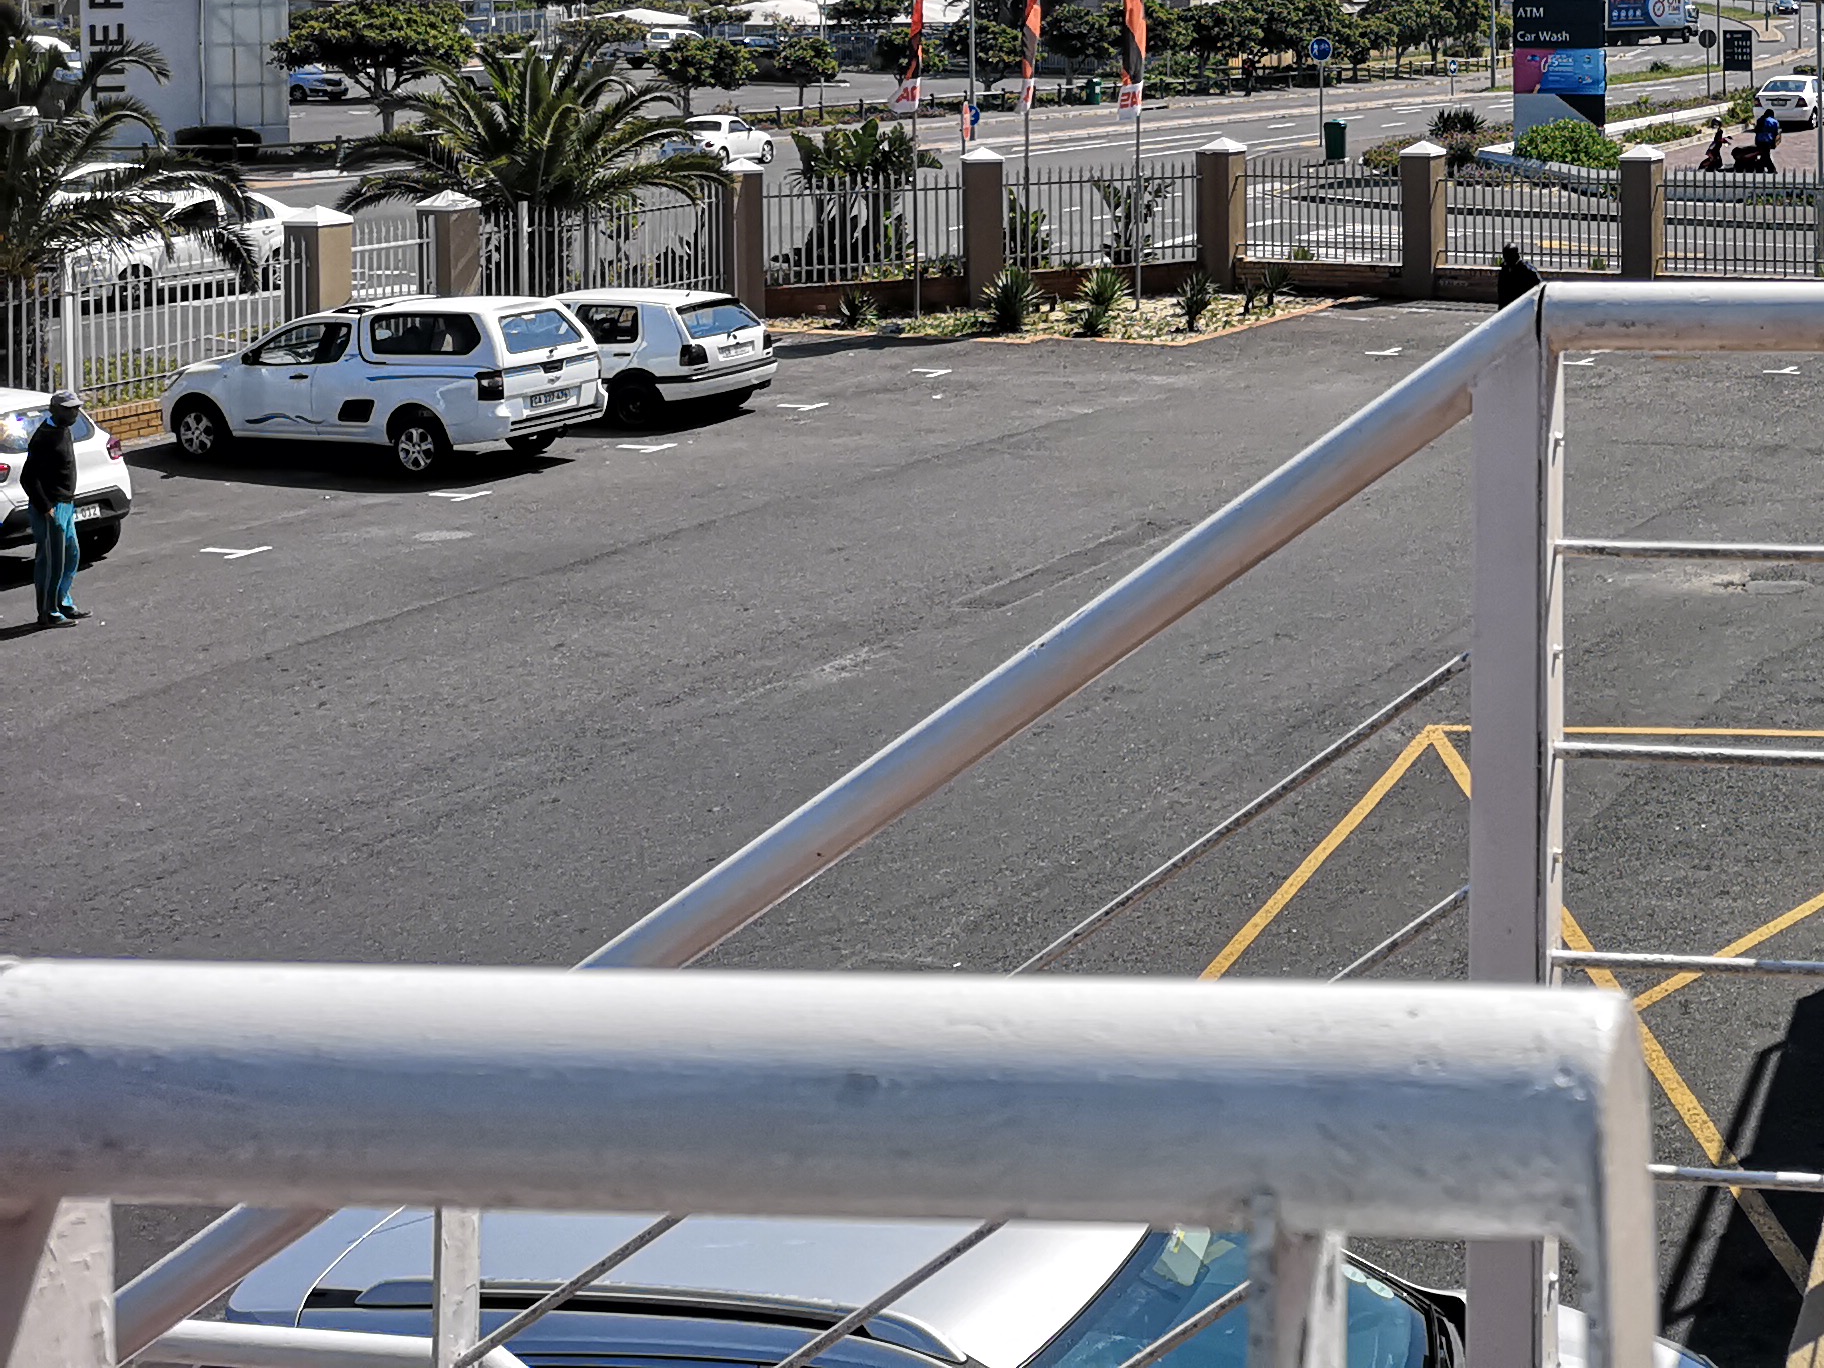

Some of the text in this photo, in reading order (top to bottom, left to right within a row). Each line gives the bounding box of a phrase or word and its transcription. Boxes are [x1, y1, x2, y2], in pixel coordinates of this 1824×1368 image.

[1516, 7, 1544, 18] ATM
[1516, 31, 1570, 42] Car Wash
